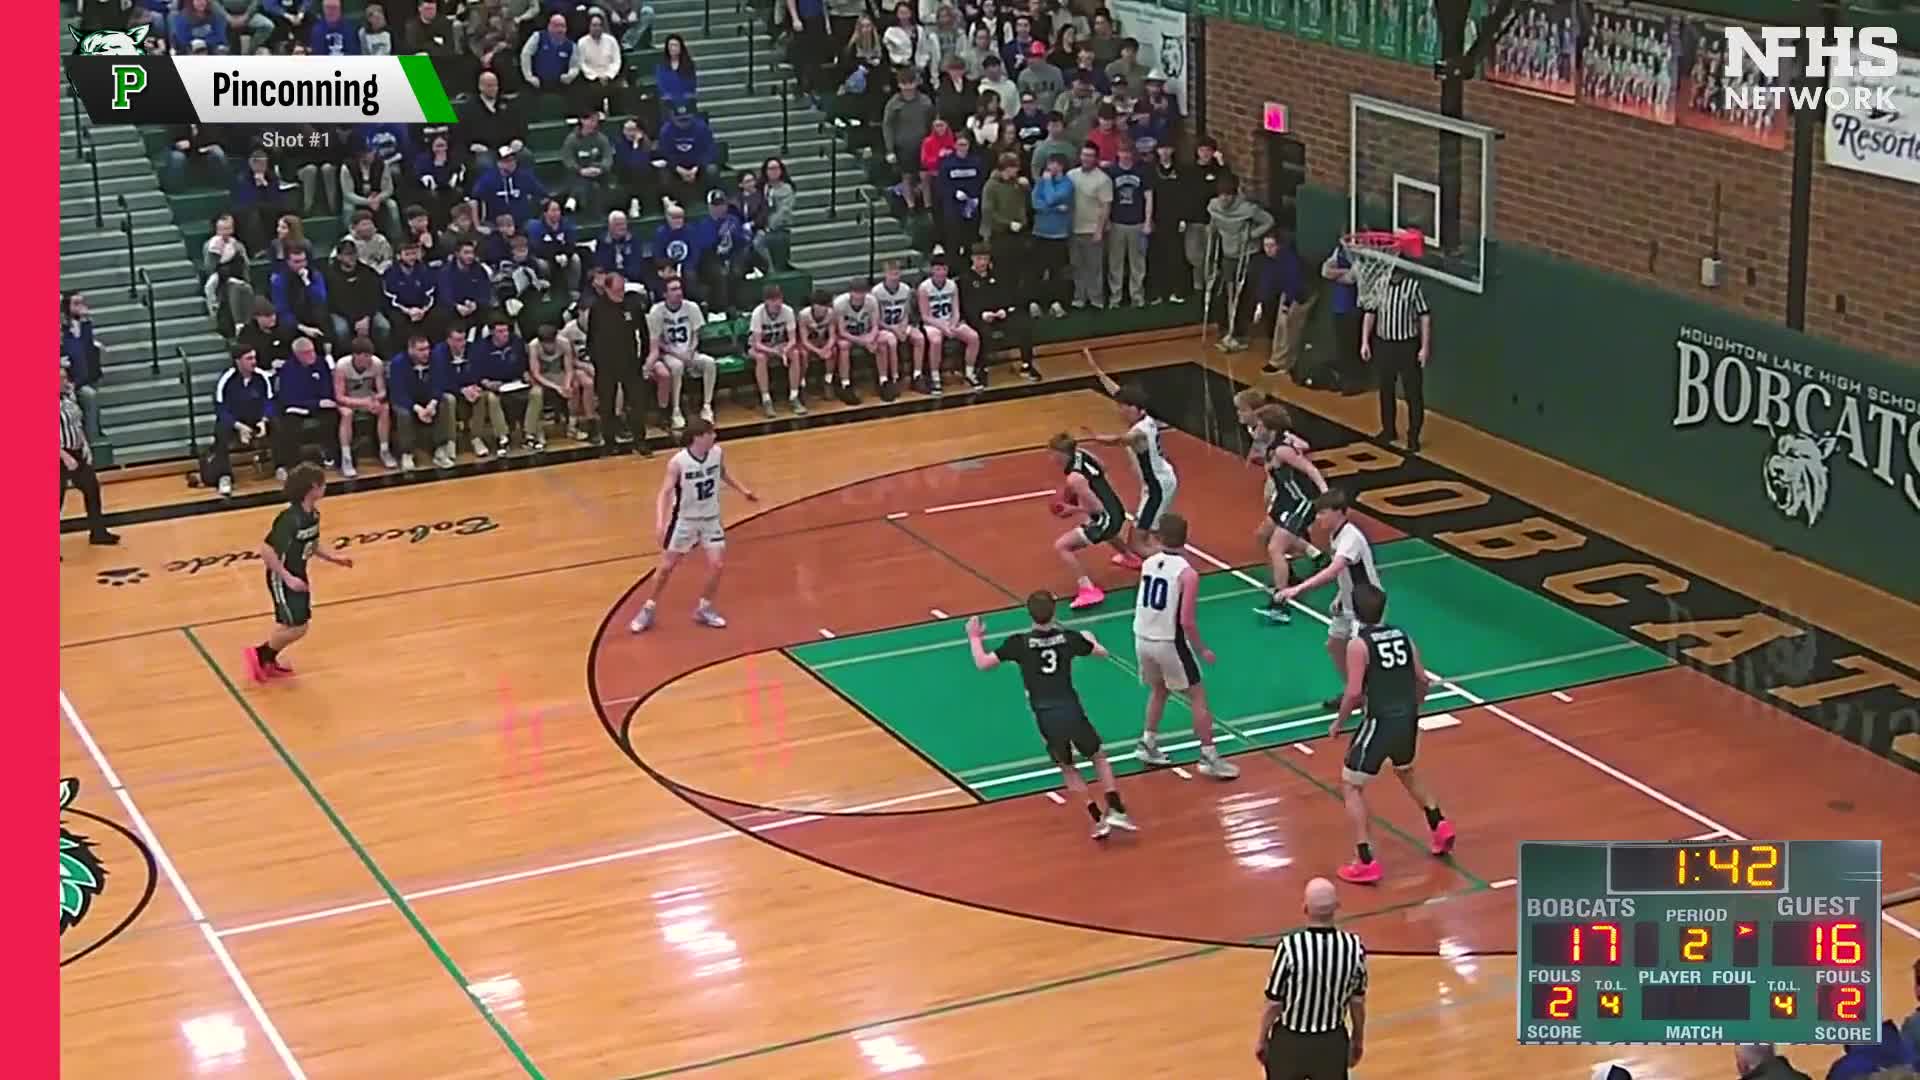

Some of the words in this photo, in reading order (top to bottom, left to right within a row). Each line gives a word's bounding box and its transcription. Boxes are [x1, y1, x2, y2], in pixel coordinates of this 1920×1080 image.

[1681, 326, 1768, 363] HOUGHTON
[1773, 356, 1814, 379] LAKE
[1819, 369, 1861, 396] HIGH
[694, 478, 715, 502] 12
[332, 515, 499, 551] Bobcat
[167, 549, 262, 576] ride
[1143, 575, 1169, 611] 10
[1040, 648, 1057, 674] 3
[1377, 639, 1408, 669] 55
